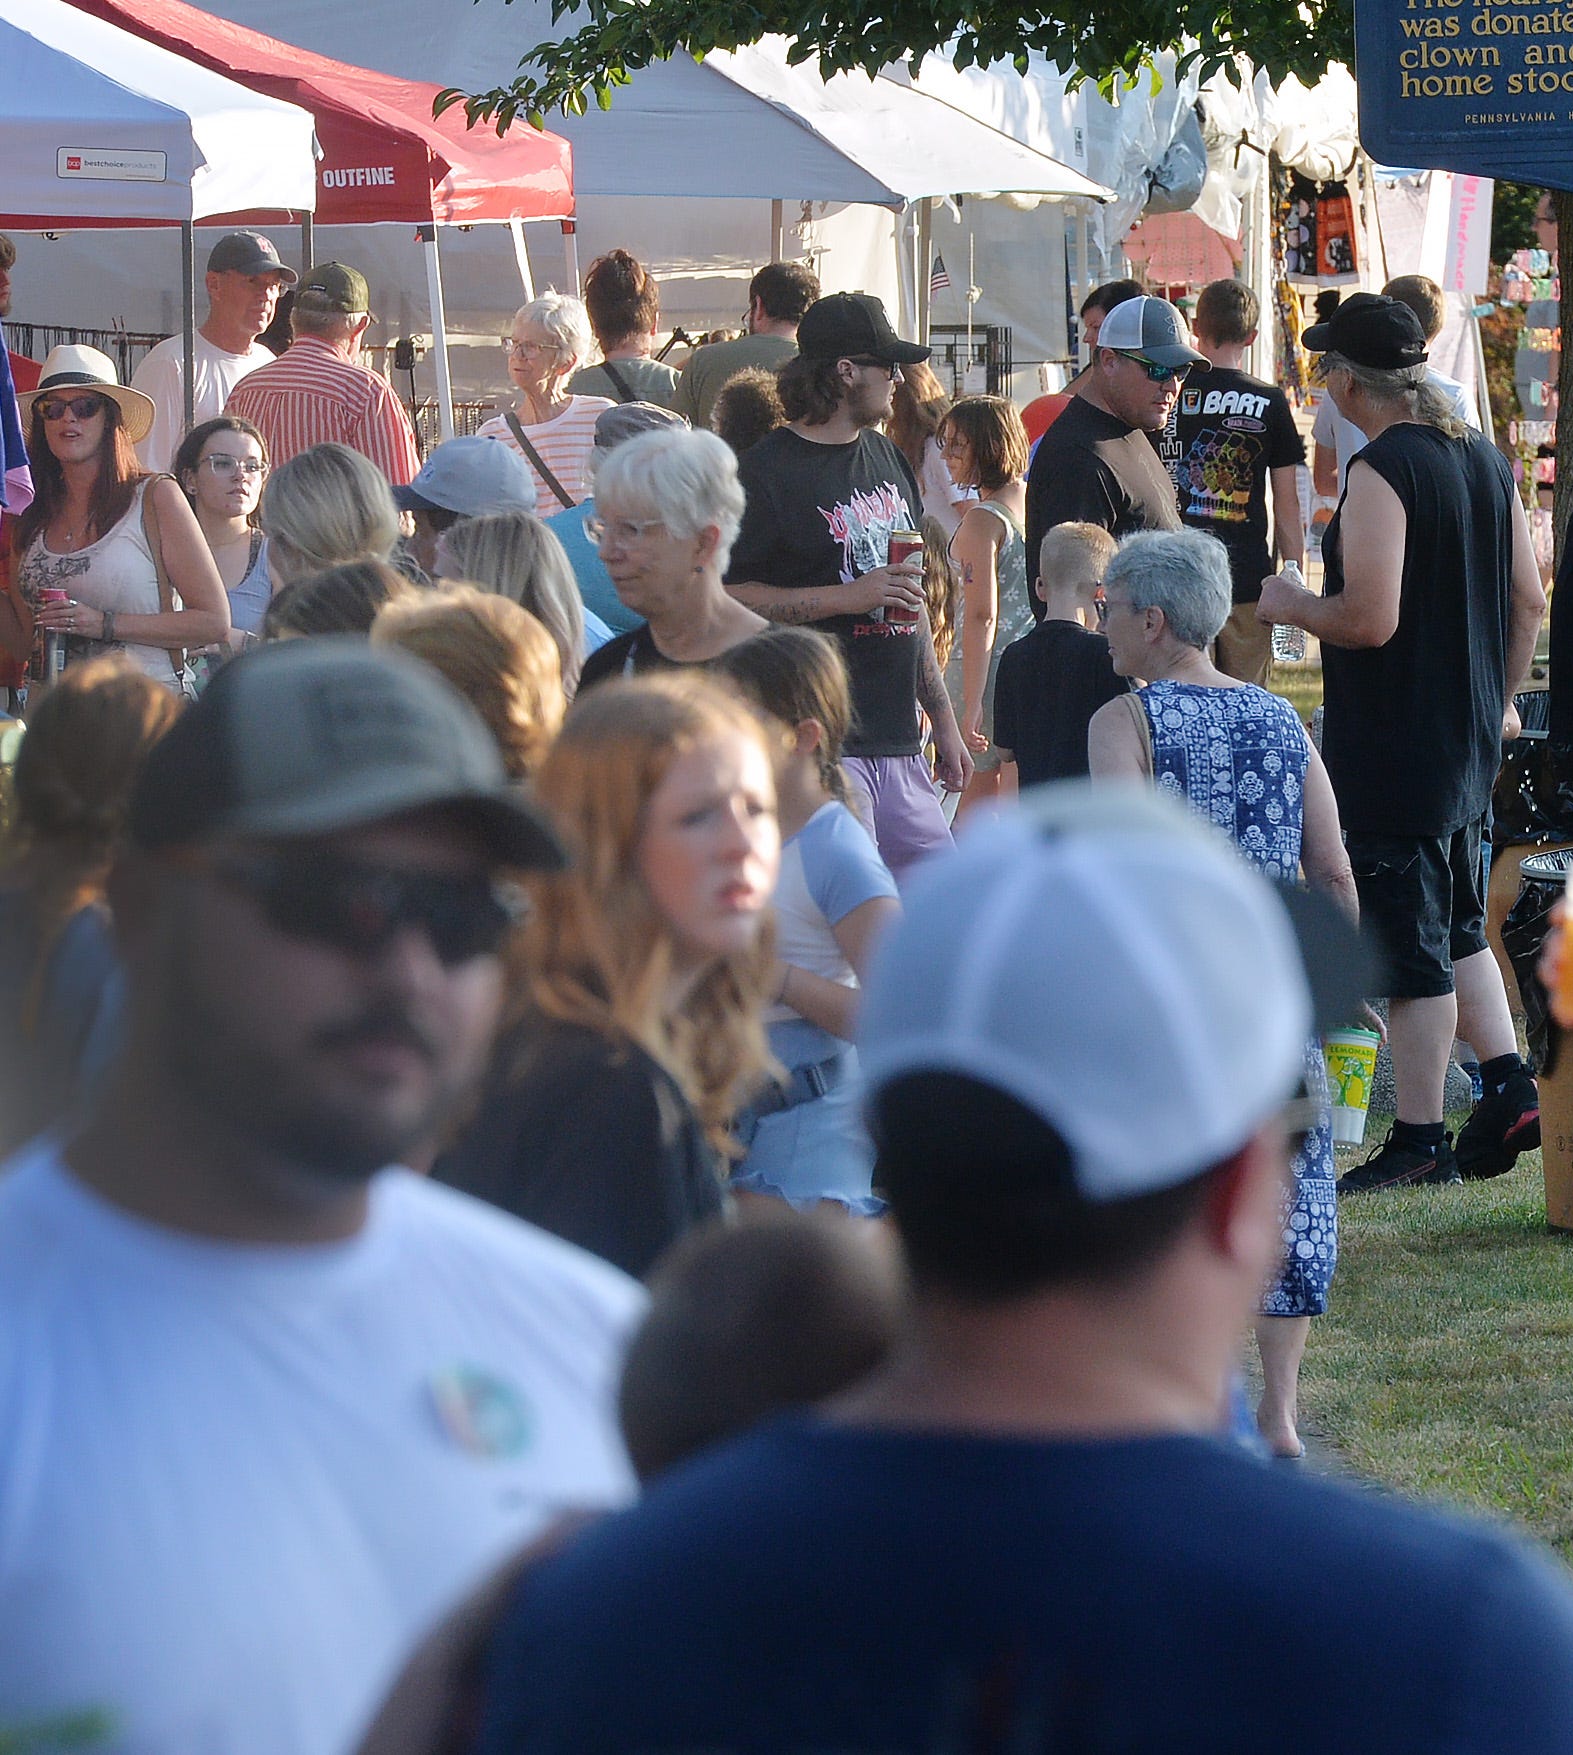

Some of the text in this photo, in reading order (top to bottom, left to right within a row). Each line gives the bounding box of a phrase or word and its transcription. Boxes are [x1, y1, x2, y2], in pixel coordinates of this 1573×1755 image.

[1400, 16, 1460, 37] was
[1399, 41, 1500, 68] clown
[1401, 71, 1493, 97] home
[1465, 111, 1556, 124] PENNSYLVANIA
[322, 166, 395, 188] OUTFINE
[1203, 390, 1271, 419] BART
